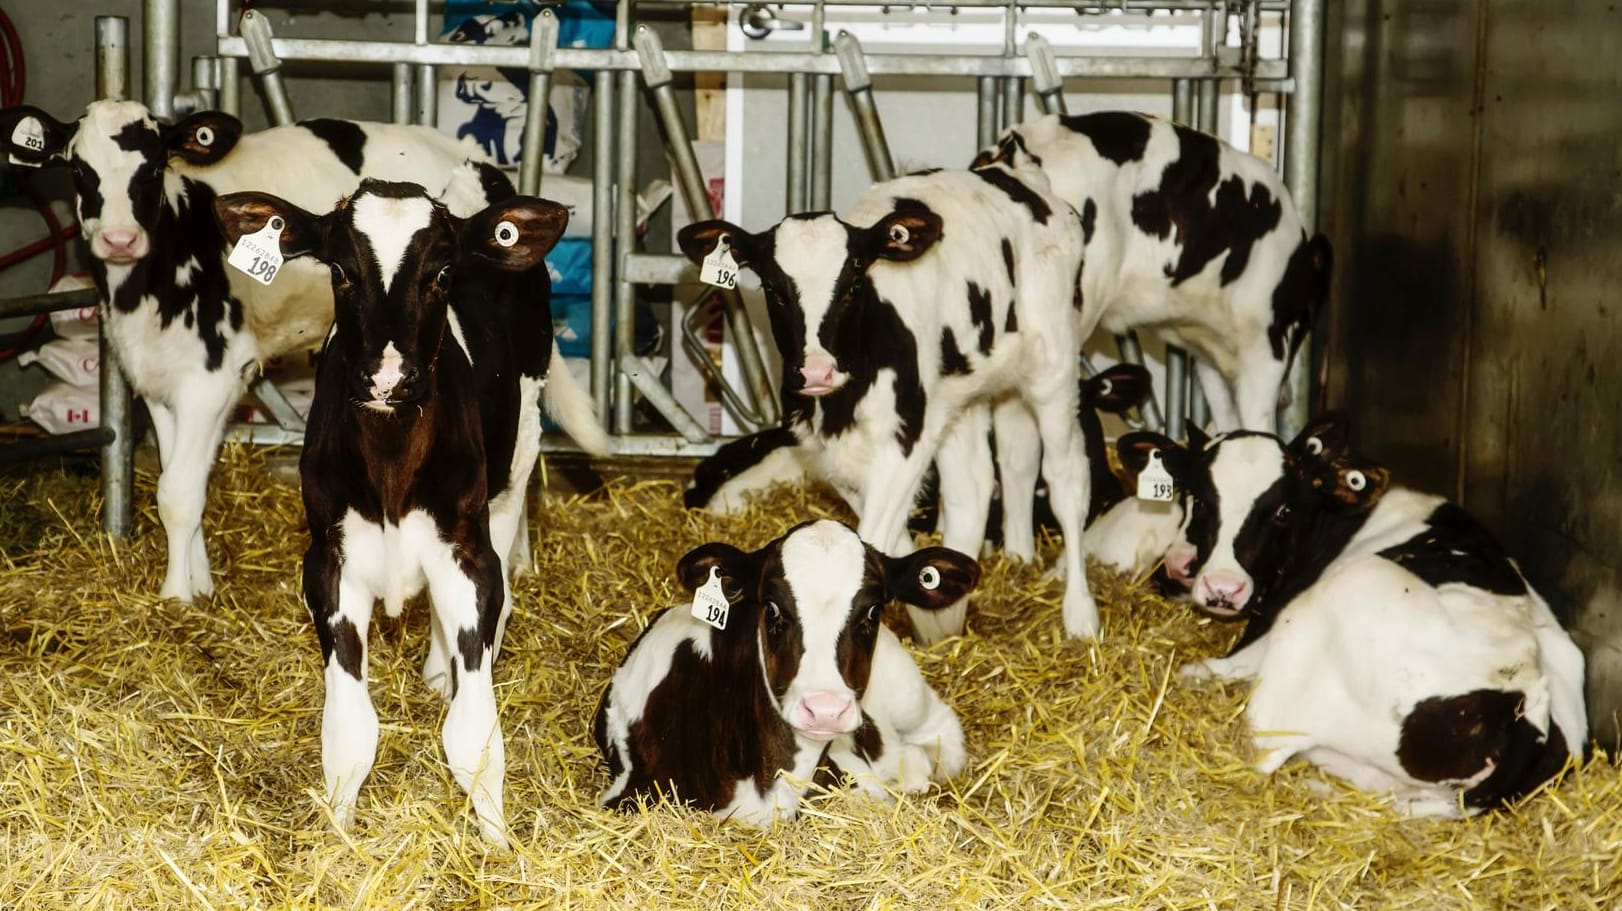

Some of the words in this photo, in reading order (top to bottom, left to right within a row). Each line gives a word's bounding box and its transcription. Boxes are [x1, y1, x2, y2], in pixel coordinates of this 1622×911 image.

[25, 137, 42, 149] 201
[247, 256, 276, 282] 198
[715, 269, 736, 287] 196
[1153, 484, 1172, 499] 193
[706, 604, 726, 627] 194
